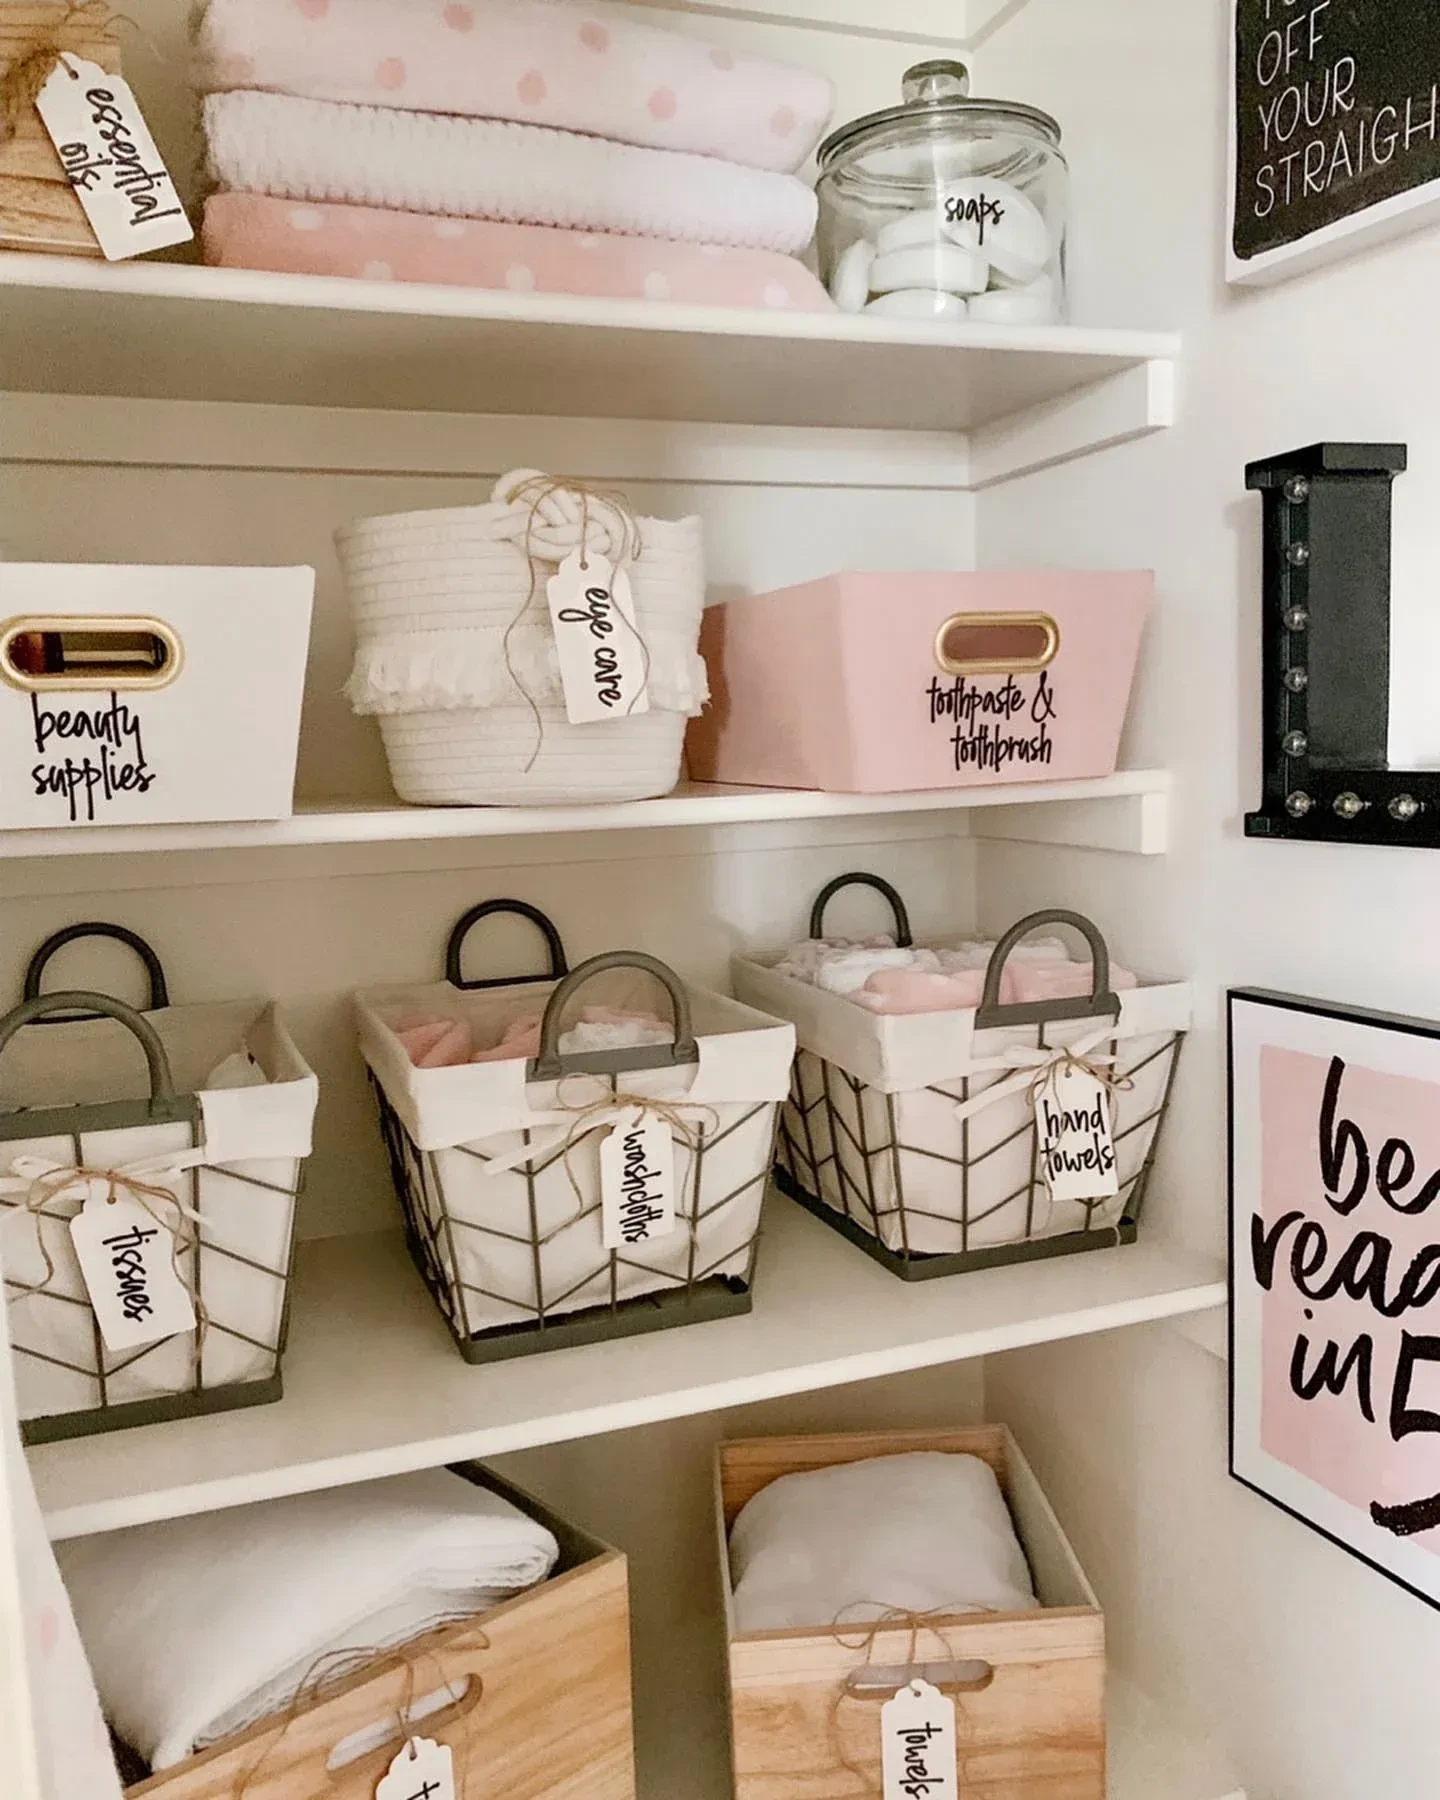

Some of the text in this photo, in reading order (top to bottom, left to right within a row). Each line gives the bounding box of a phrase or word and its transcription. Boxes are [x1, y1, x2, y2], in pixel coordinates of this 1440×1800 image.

[1256, 0, 1330, 86] OFF
[1257, 56, 1356, 151] YOUR
[58, 141, 113, 191] oils
[85, 87, 182, 227] essential
[944, 192, 1005, 246] soaps
[557, 586, 622, 708] eye care
[30, 690, 147, 767] beauty
[925, 669, 1057, 737] toothpaste &
[31, 743, 157, 821] supplies
[950, 722, 1052, 773] toothbrush
[1042, 1091, 1106, 1139] hand
[1318, 1055, 1440, 1216] be
[618, 1128, 664, 1244] washcloths
[1039, 1132, 1116, 1182] towels
[101, 1225, 159, 1323] tissues
[1289, 1307, 1376, 1424] in
[896, 1721, 945, 1800] towels
